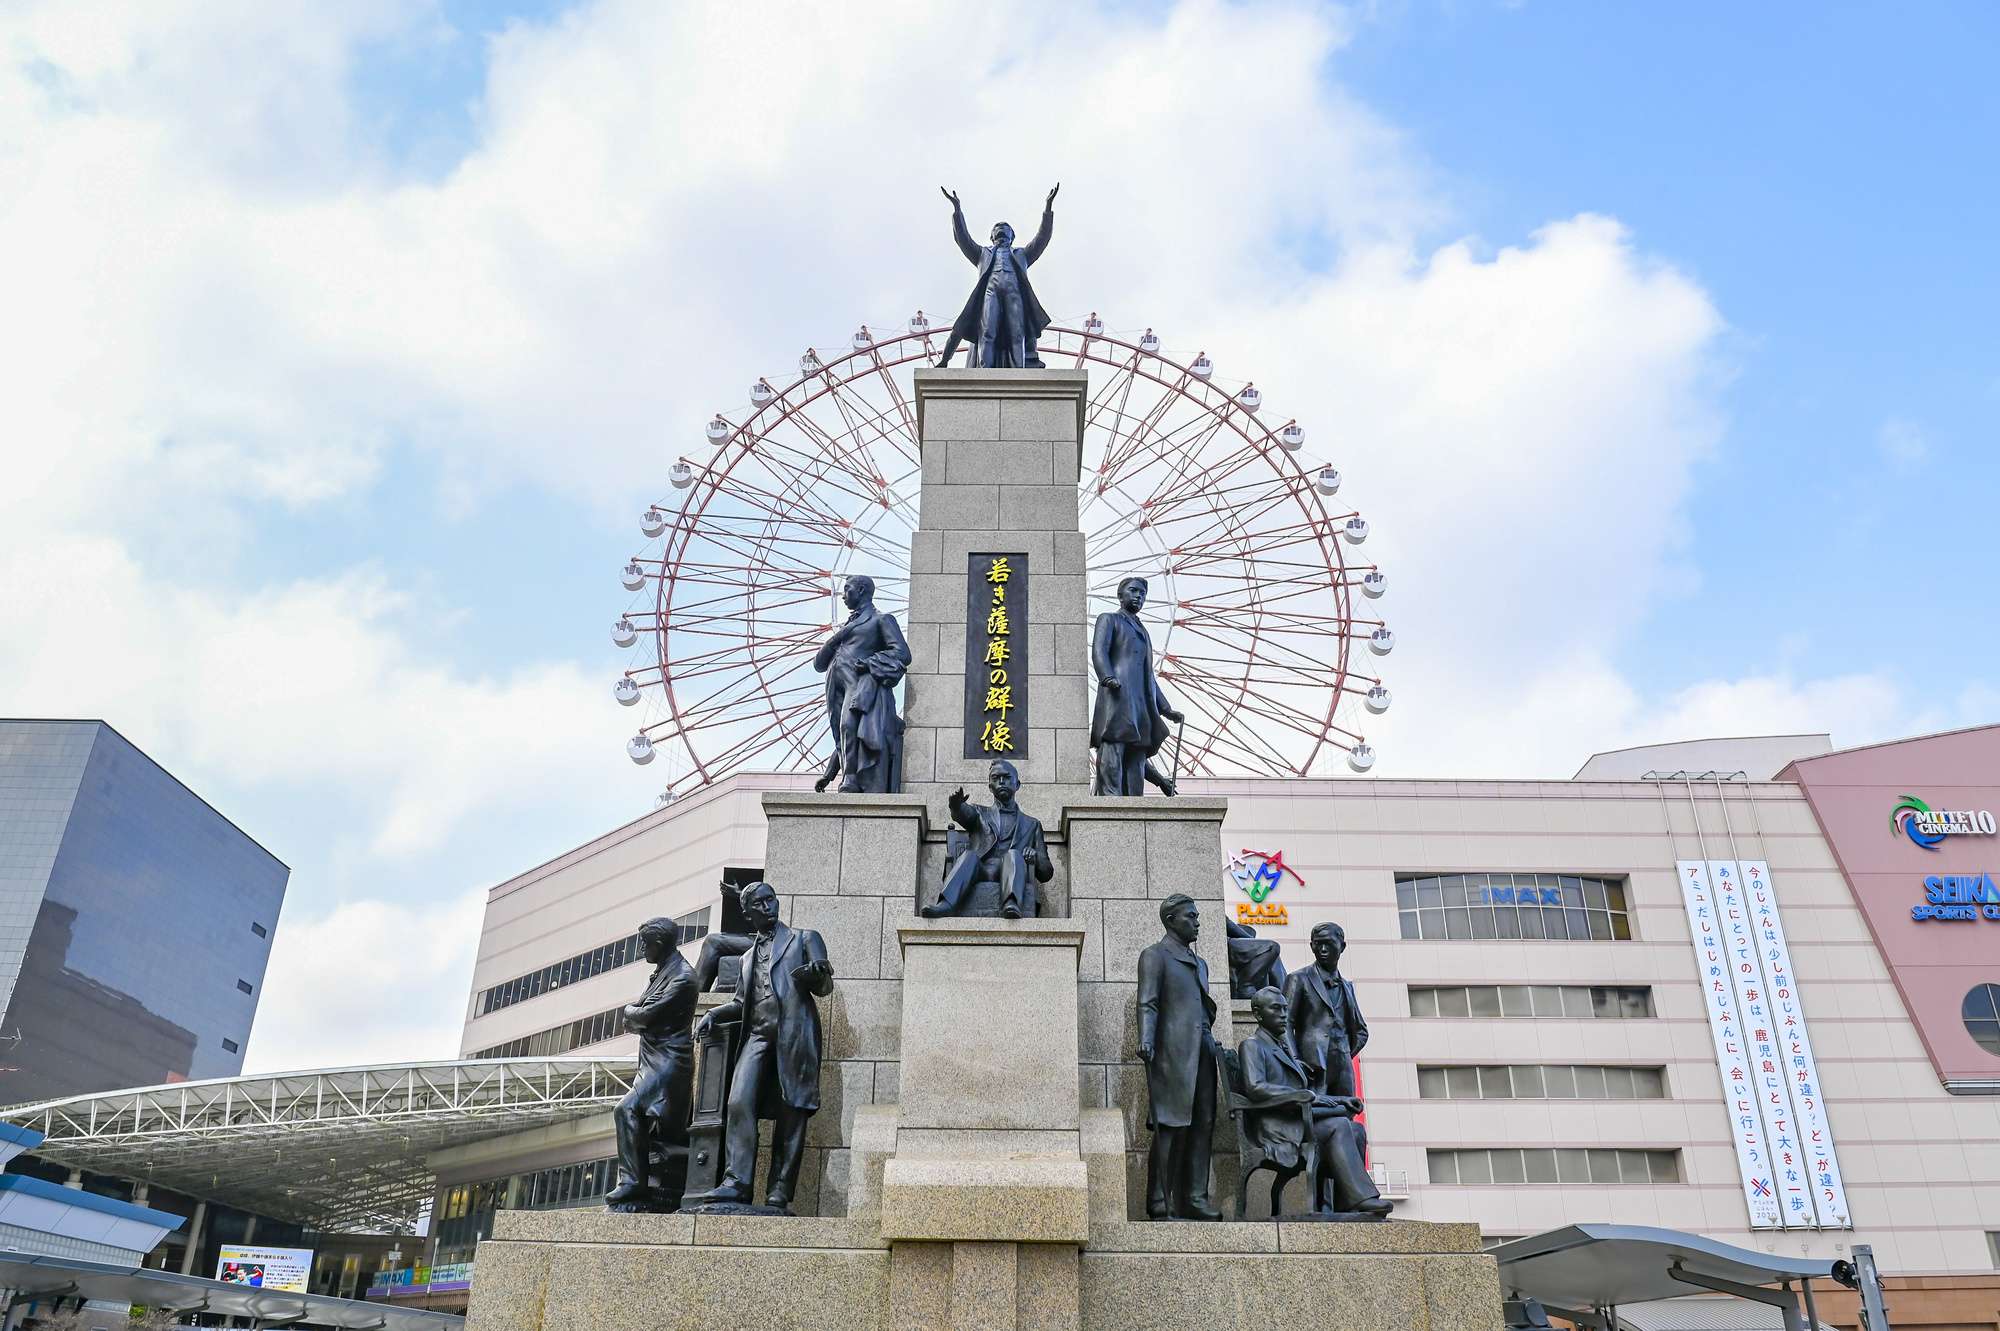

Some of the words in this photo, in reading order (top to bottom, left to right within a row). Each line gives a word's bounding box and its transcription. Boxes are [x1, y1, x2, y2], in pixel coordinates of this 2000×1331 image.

[980, 557, 1014, 752] 若き薩摩の群像
[1919, 823, 1969, 834] CINEMA
[1481, 887, 1560, 904] IMAX
[1236, 904, 1288, 917] PLAZA
[1911, 905, 1977, 920] SPORTS
[1719, 867, 1807, 1217] あなたにとっての一歩は、鹿児島にとって大きな一歩。
